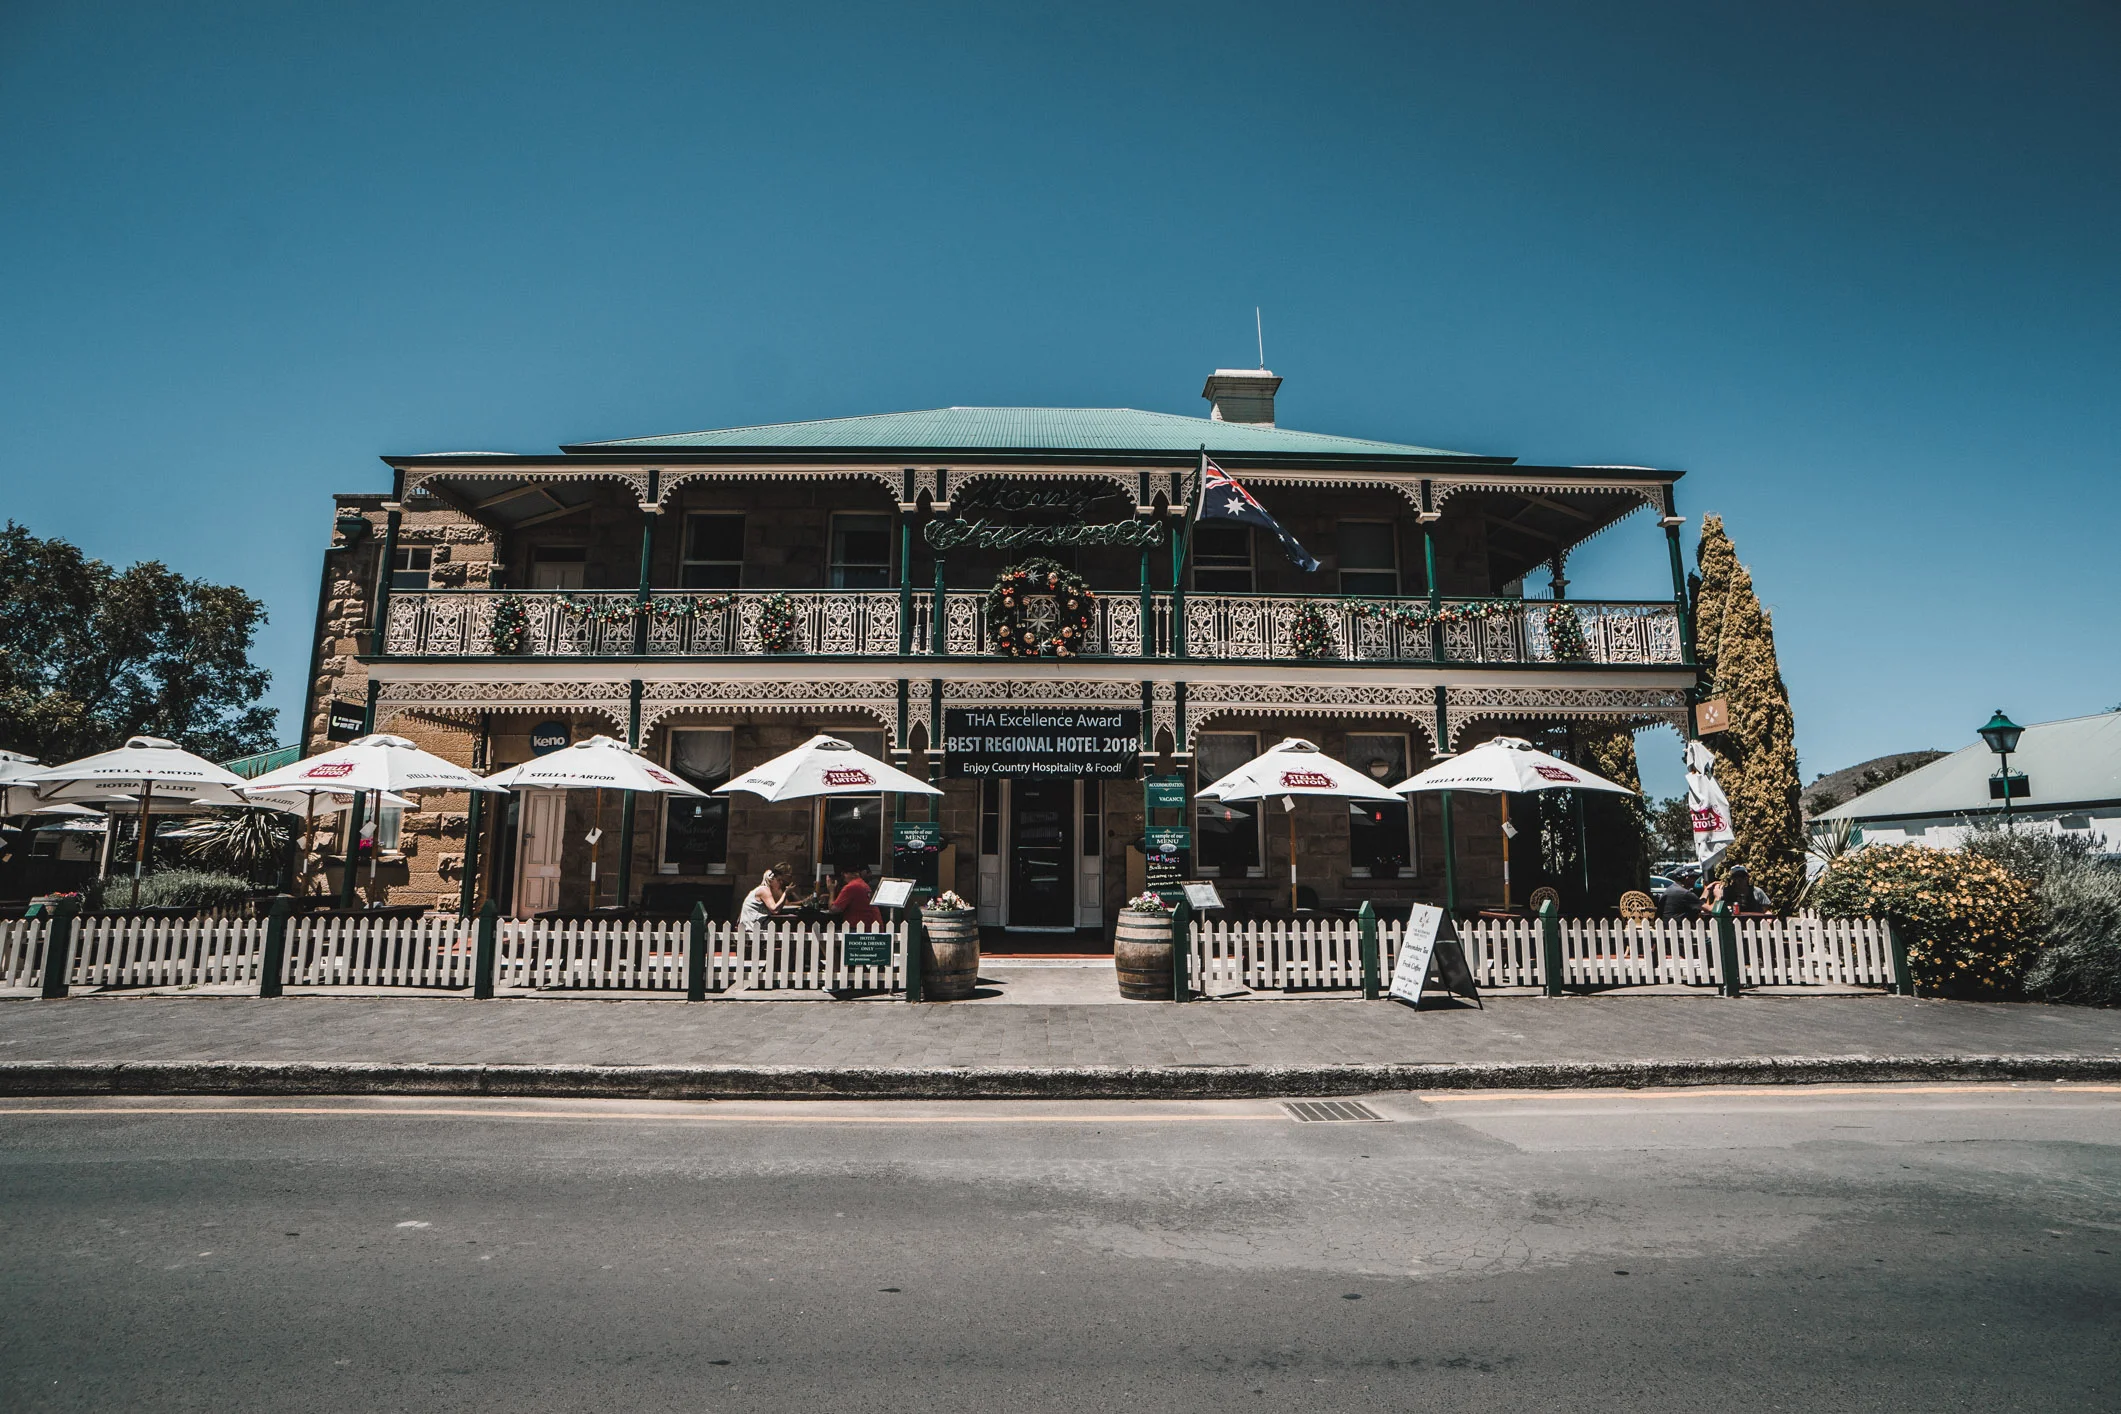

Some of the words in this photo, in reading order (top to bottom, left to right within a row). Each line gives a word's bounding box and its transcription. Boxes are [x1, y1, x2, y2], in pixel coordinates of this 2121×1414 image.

[924, 518, 1165, 550] Christmas
[965, 713, 996, 727] THA
[1000, 712, 1073, 727] Excellence
[1076, 713, 1122, 727] Award
[533, 735, 565, 747] keno
[948, 736, 982, 752] BEST
[985, 736, 1054, 752] REGIONAL
[1056, 736, 1101, 753] HOTEL
[1103, 737, 1138, 753] 2018
[963, 762, 990, 775] Enjoy
[992, 762, 1031, 774] Country
[1032, 762, 1084, 774] Hospitality
[1085, 763, 1094, 773] &
[1095, 762, 1122, 773] Food!
[578, 773, 616, 781] ARTOIS
[1425, 777, 1456, 785] STELLA
[1692, 818, 1717, 829] RTOIS
